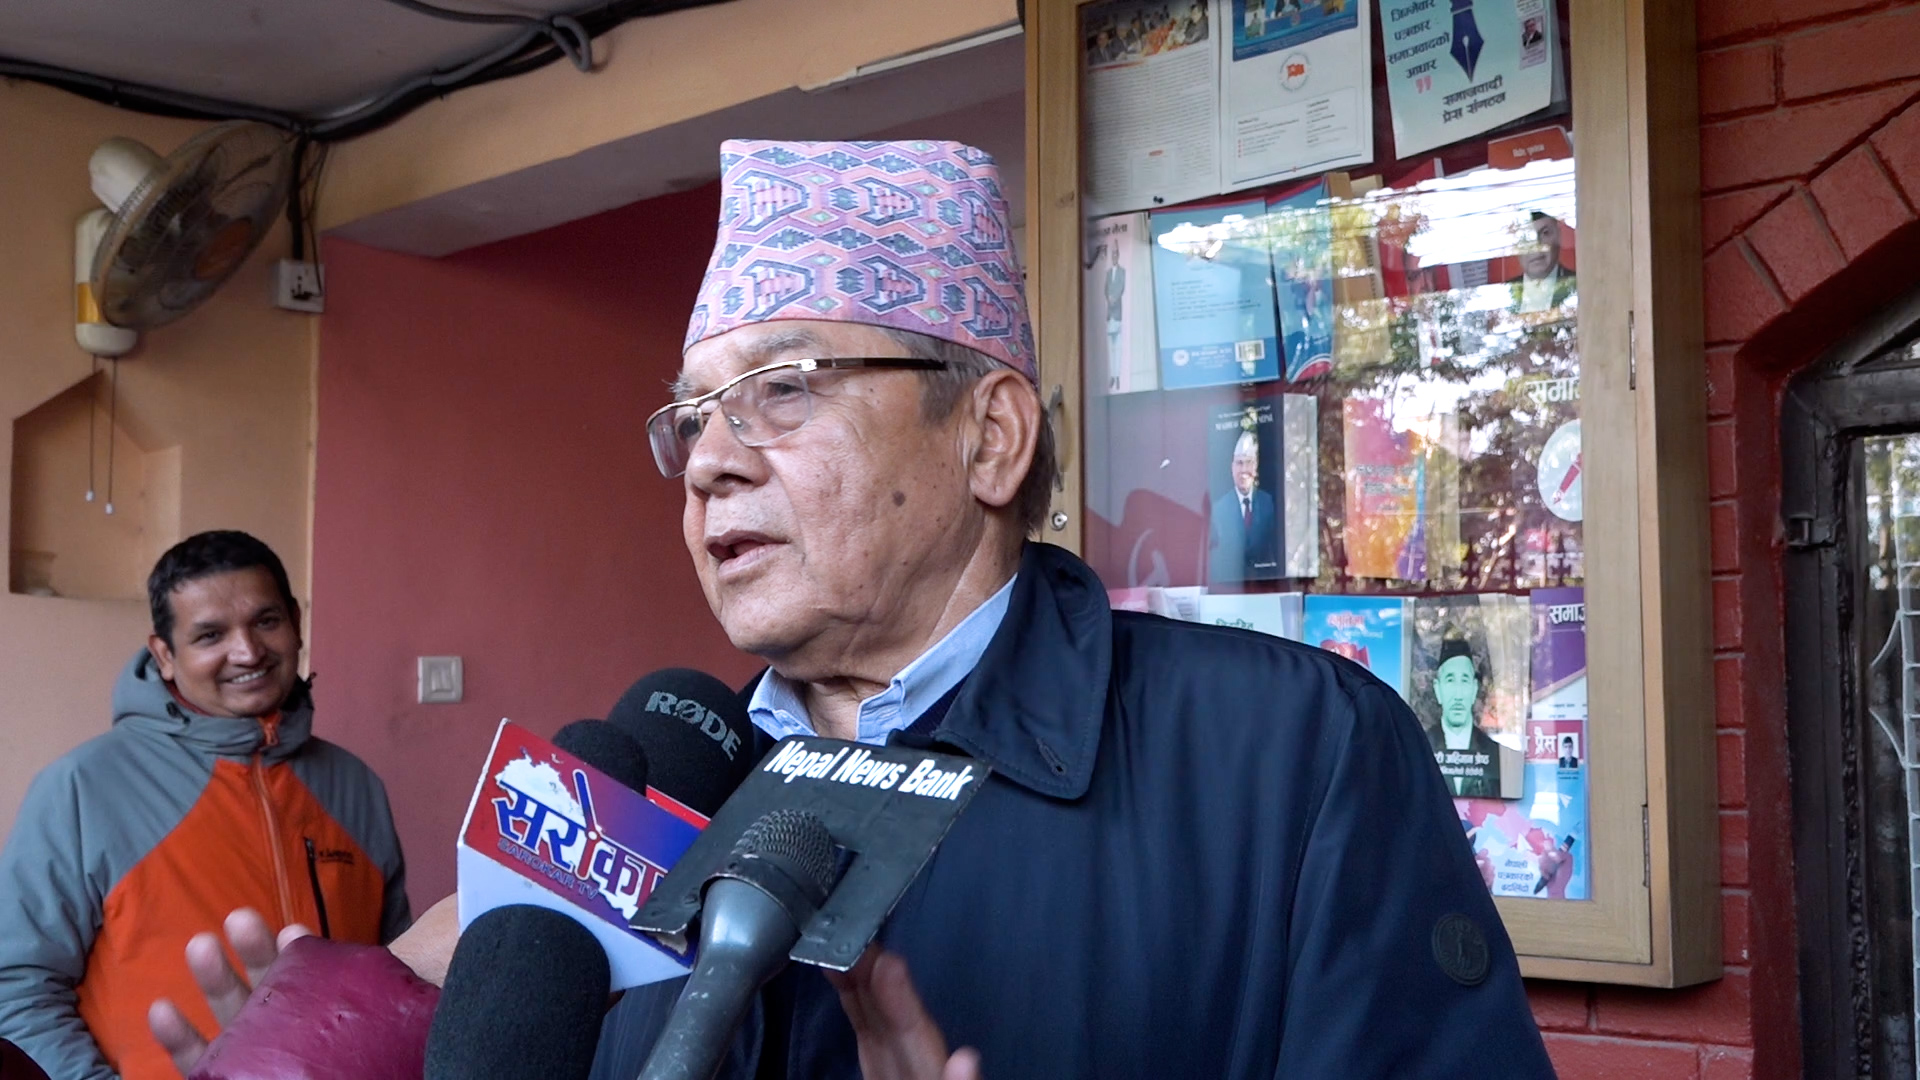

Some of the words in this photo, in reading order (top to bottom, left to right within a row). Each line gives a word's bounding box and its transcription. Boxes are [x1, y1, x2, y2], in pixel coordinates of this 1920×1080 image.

[1394, 20, 1430, 40] पत्रकार
[1388, 32, 1449, 64] समाजवादको
[1406, 59, 1437, 78] आधार
[1443, 74, 1503, 105] समाजवादी
[1443, 108, 1462, 124] प्रेस
[645, 691, 741, 761] RØDE
[763, 740, 850, 784] Nepal
[830, 748, 907, 790] News
[898, 758, 973, 801] Bank
[491, 770, 669, 909] सरोका
[497, 838, 575, 889] SAROKAR
[577, 881, 600, 900] TV
